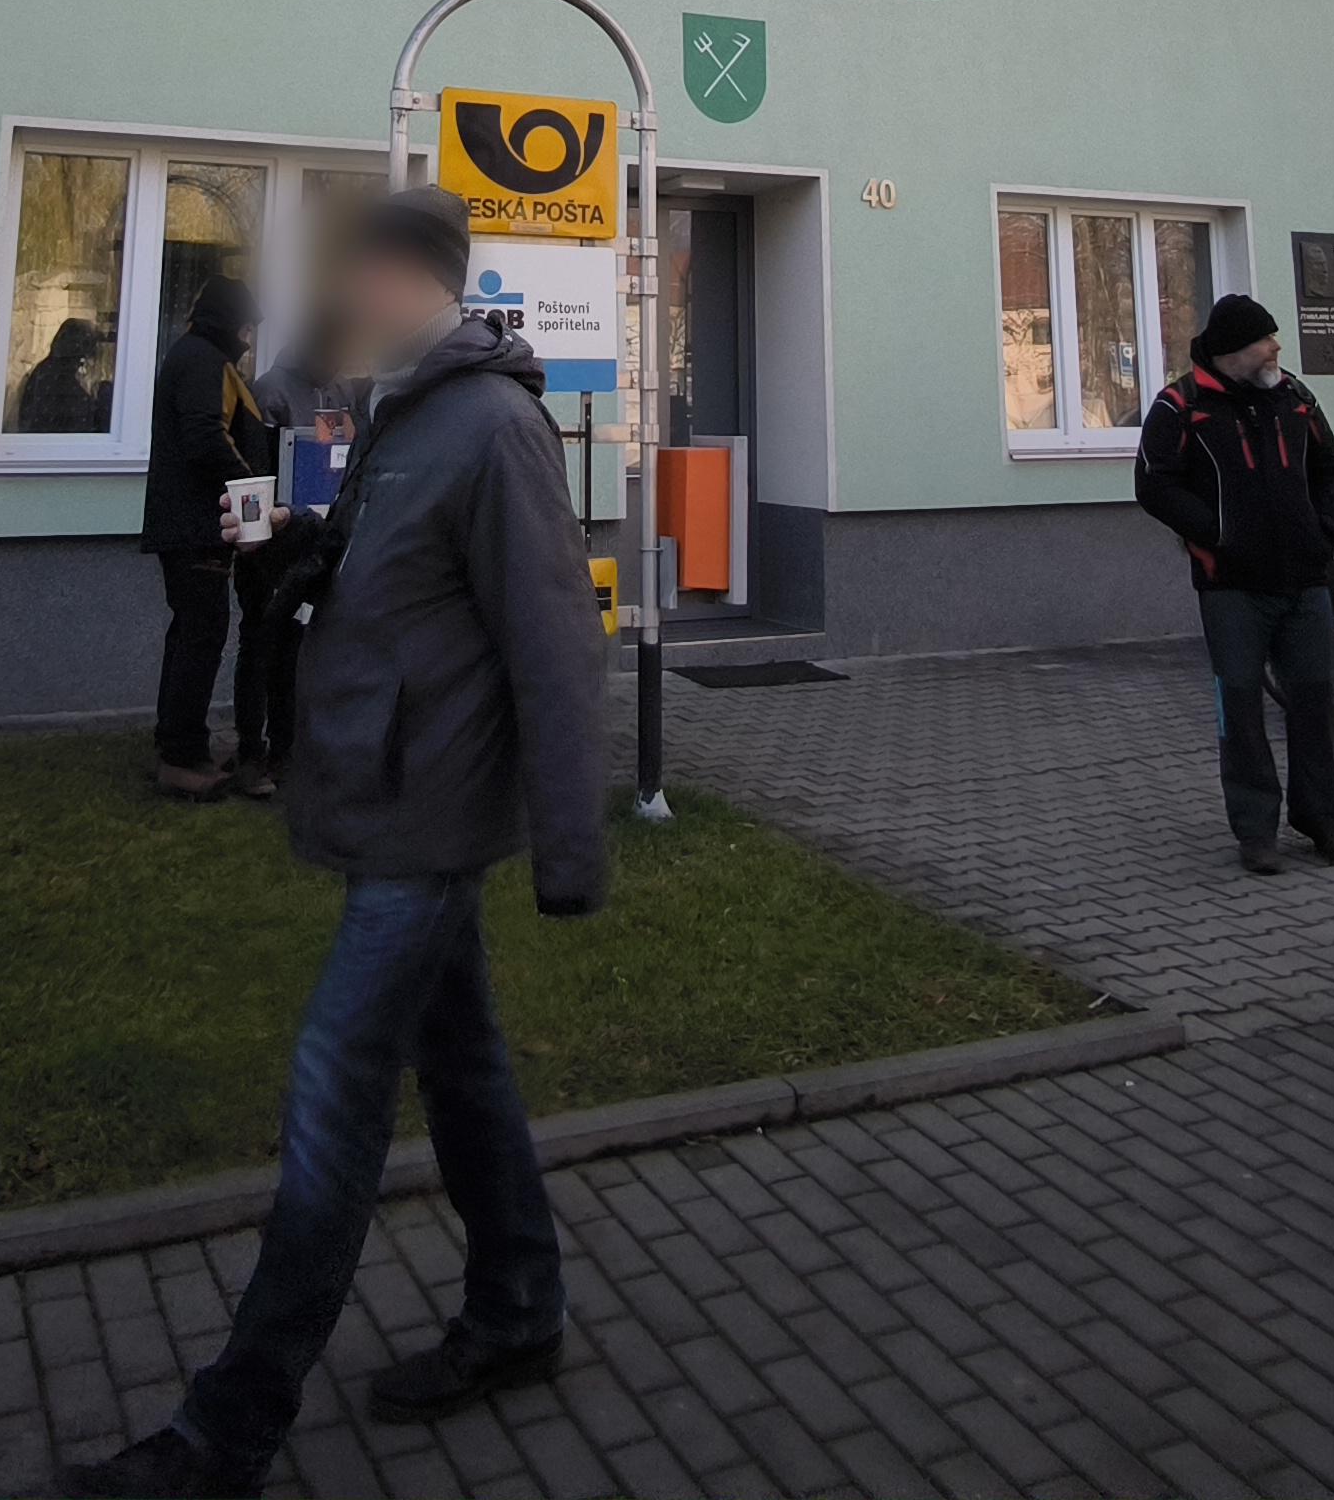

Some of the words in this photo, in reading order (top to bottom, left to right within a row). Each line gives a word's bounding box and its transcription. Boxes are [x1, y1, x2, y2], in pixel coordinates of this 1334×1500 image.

[862, 177, 896, 208] 40
[460, 193, 527, 220] ESKÁ
[532, 199, 604, 225] POŠTA
[537, 301, 590, 315] Poštovní
[537, 318, 601, 333] spořitelna
